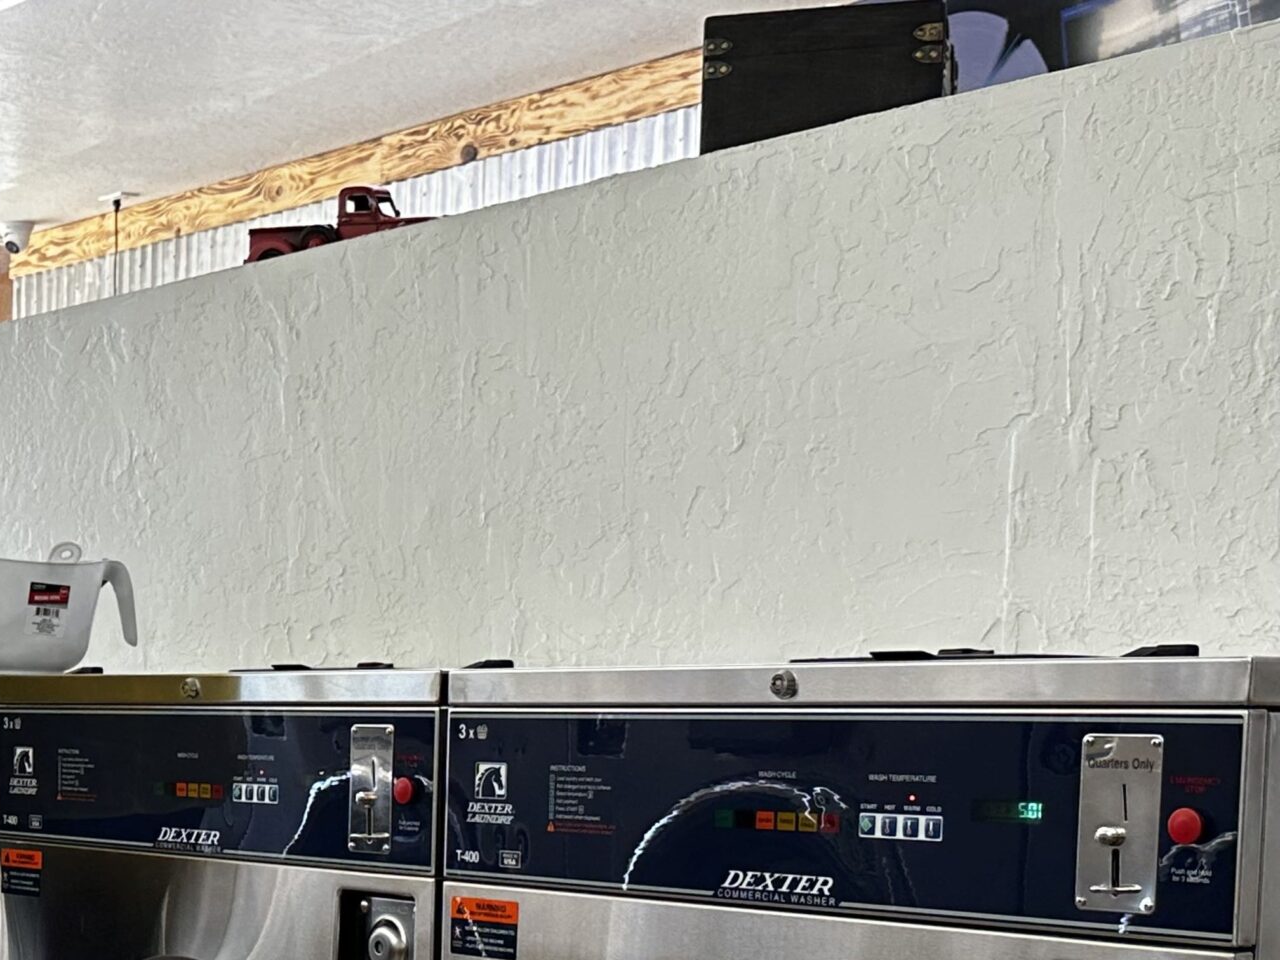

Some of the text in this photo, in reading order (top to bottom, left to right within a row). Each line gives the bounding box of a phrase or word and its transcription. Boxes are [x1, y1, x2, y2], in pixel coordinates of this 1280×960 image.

[3, 716, 8, 729] 3
[458, 724, 474, 739] 3 x
[1087, 758, 1156, 772] Quarters Only
[888, 774, 937, 783] TEMPERATURE
[466, 802, 513, 814] DEXTER
[466, 814, 515, 825] LAUNDRY
[157, 827, 220, 846] DEXTER
[456, 849, 480, 864] T-400
[722, 870, 834, 896] DEXTER
[717, 888, 837, 907] COMMERCIAL WASHER
